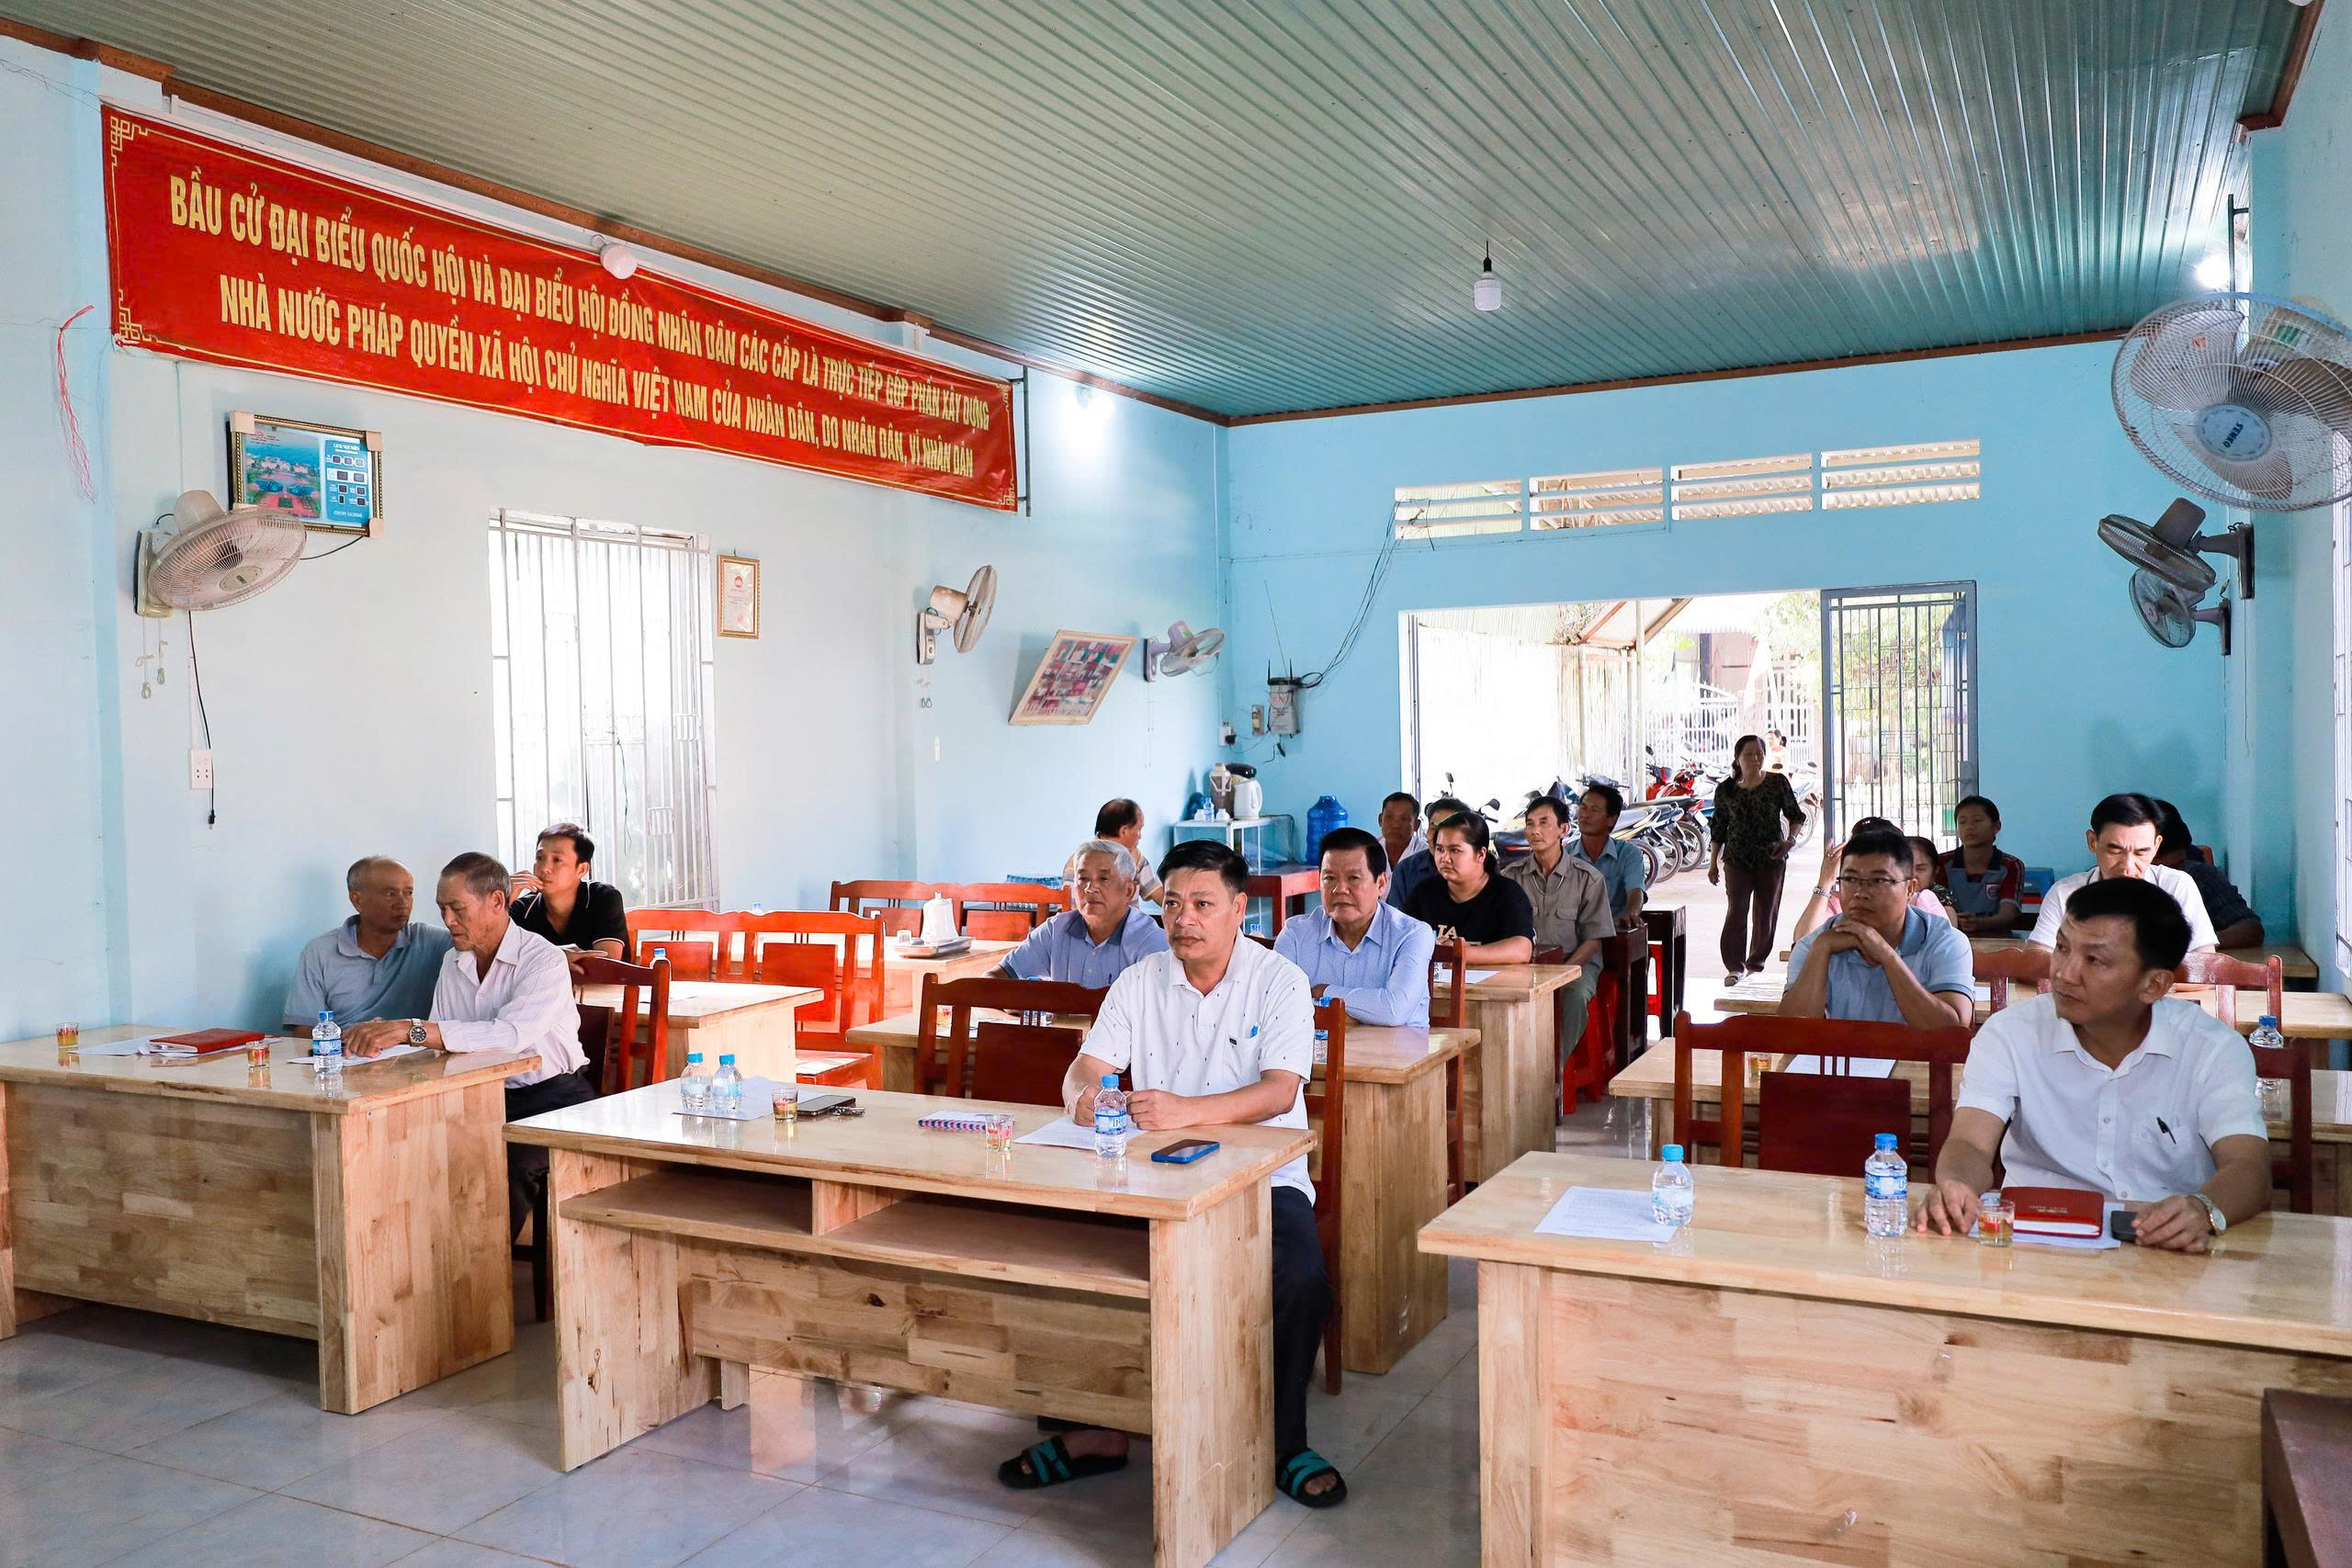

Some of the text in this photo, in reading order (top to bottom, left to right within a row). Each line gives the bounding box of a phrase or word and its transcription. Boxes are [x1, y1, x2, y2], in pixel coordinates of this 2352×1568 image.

[170, 165, 221, 235] BẦU
[230, 183, 265, 245] CỬ
[269, 204, 309, 265] ĐẠI
[315, 206, 366, 272] BIỂU
[371, 226, 427, 288] QUỐC
[431, 244, 466, 307] HỘI
[469, 254, 496, 305] VÀ
[499, 267, 530, 321] ĐẠI
[536, 266, 574, 325] BIỂU
[578, 284, 605, 340] HỘI
[608, 288, 655, 345] ĐỒNG
[658, 310, 703, 357] NHÂN
[705, 321, 736, 366] DÂN
[740, 330, 769, 374] CÁC
[803, 346, 819, 388] LÀ
[822, 355, 854, 400] TRỰC
[857, 359, 884, 401] TIẾP
[886, 369, 909, 407] GÓP
[911, 376, 940, 418] PHẦN
[942, 385, 964, 423] XÂY
[963, 395, 990, 434] DỰNG
[220, 273, 974, 479] NHÀ NƯỚC PHÁP QUYỀN XÃ HỘI CHỦ NGHĨA VIỆT NAM CỦA NHÂN DÂN, DO NHÂN DÂN, VÌ NHÂN DÂN
[2222, 423, 2244, 448] SENKO
